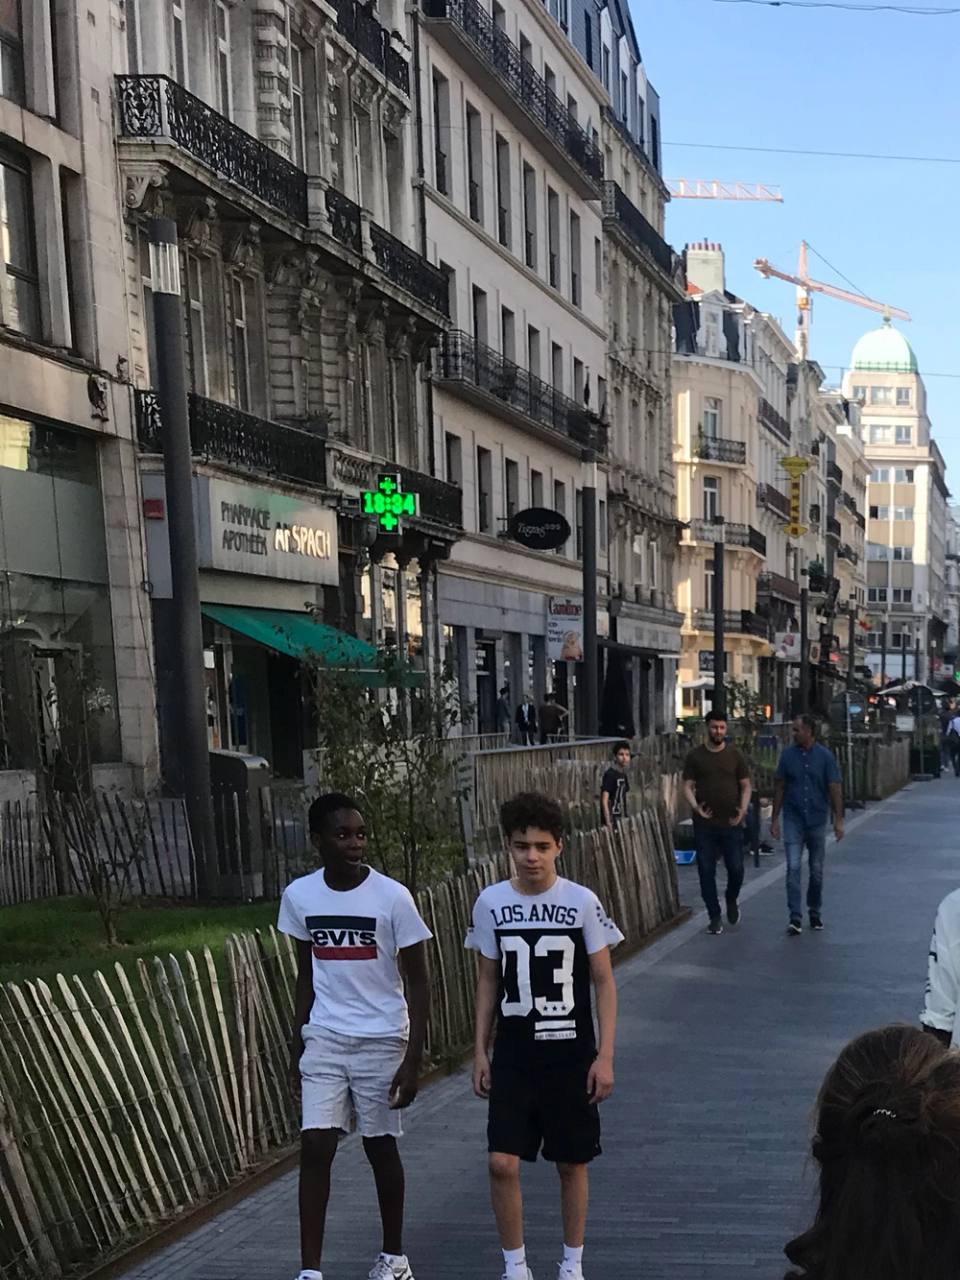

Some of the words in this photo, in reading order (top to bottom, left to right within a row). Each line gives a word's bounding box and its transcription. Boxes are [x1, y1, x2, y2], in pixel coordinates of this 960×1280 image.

[274, 521, 331, 560] ANSPACH
[490, 903, 578, 927] LOS.ANGS
[500, 935, 575, 1017] 03
